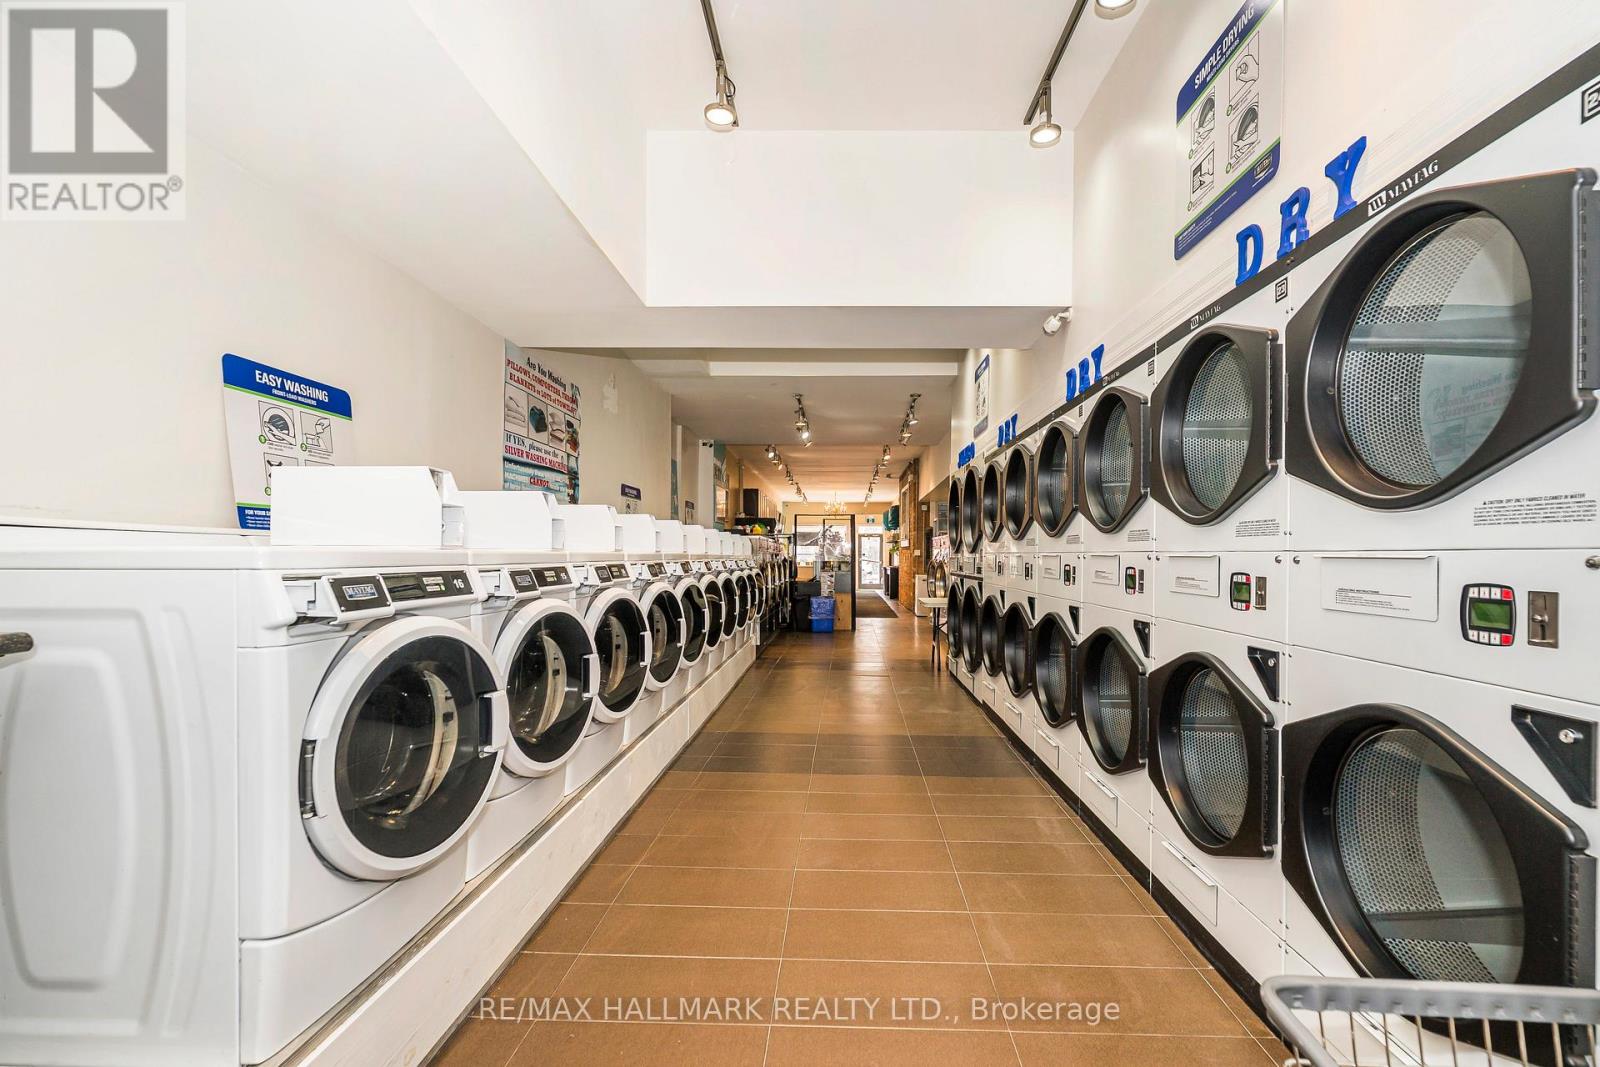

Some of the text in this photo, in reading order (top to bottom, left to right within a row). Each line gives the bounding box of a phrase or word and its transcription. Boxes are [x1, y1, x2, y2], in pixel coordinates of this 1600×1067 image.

[1194, 3, 1255, 89] SIMPLE DRYING
[1388, 159, 1439, 201] MAYTAG
[1235, 136, 1367, 287] DRY
[255, 370, 329, 402] EASY WASHING
[509, 372, 536, 393] BLANKETS
[527, 357, 567, 392] Are You Washing
[1066, 343, 1105, 403] DRY
[997, 413, 1018, 448] DRY
[505, 445, 525, 458] SILVER
[525, 451, 548, 466] WASHING
[528, 442, 543, 453] please
[345, 585, 375, 595] MAYTAG
[453, 578, 465, 589] 16
